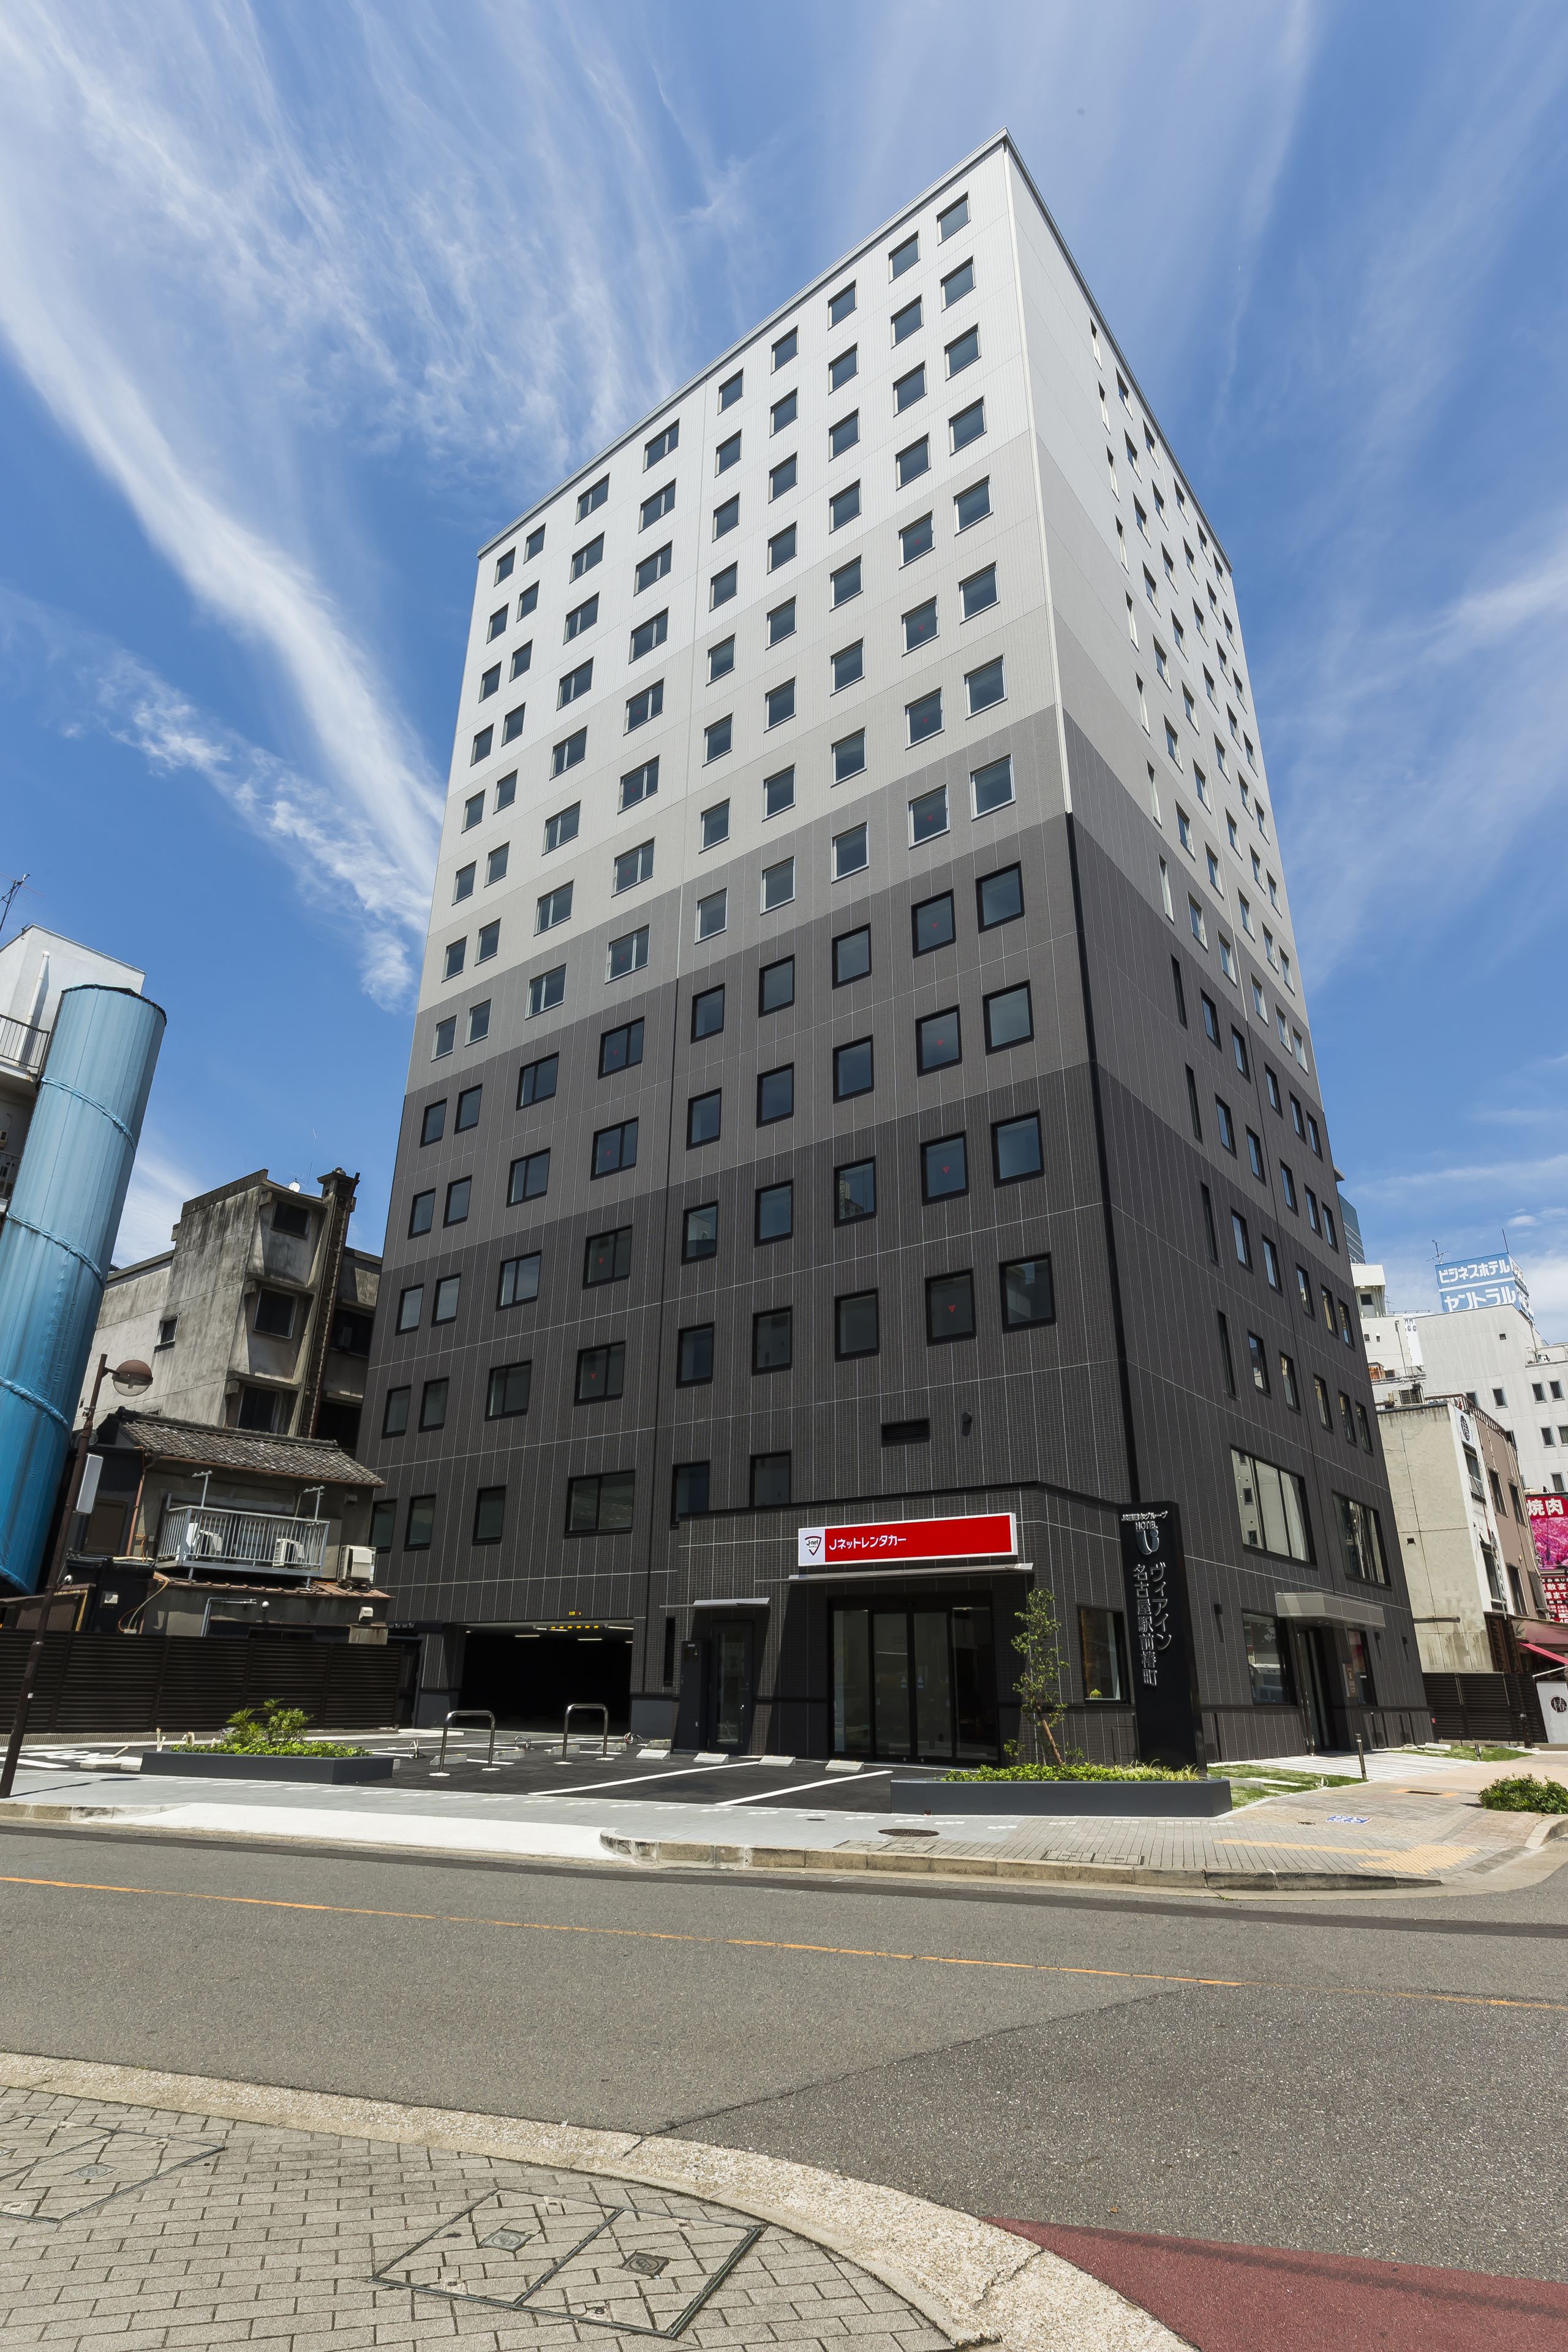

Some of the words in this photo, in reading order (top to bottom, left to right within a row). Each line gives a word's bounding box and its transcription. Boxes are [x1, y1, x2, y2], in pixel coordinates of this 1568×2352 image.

[1438, 1259, 1510, 1284] ビジネスホテル
[1526, 1498, 1564, 1516] 焼肉
[1135, 1520, 1158, 1530] HOTEL
[829, 1535, 907, 1551] Jネットレンタカー
[1150, 1562, 1172, 1651] ヴィアイン
[1133, 1564, 1158, 1686] 名古屋駅前椿町
